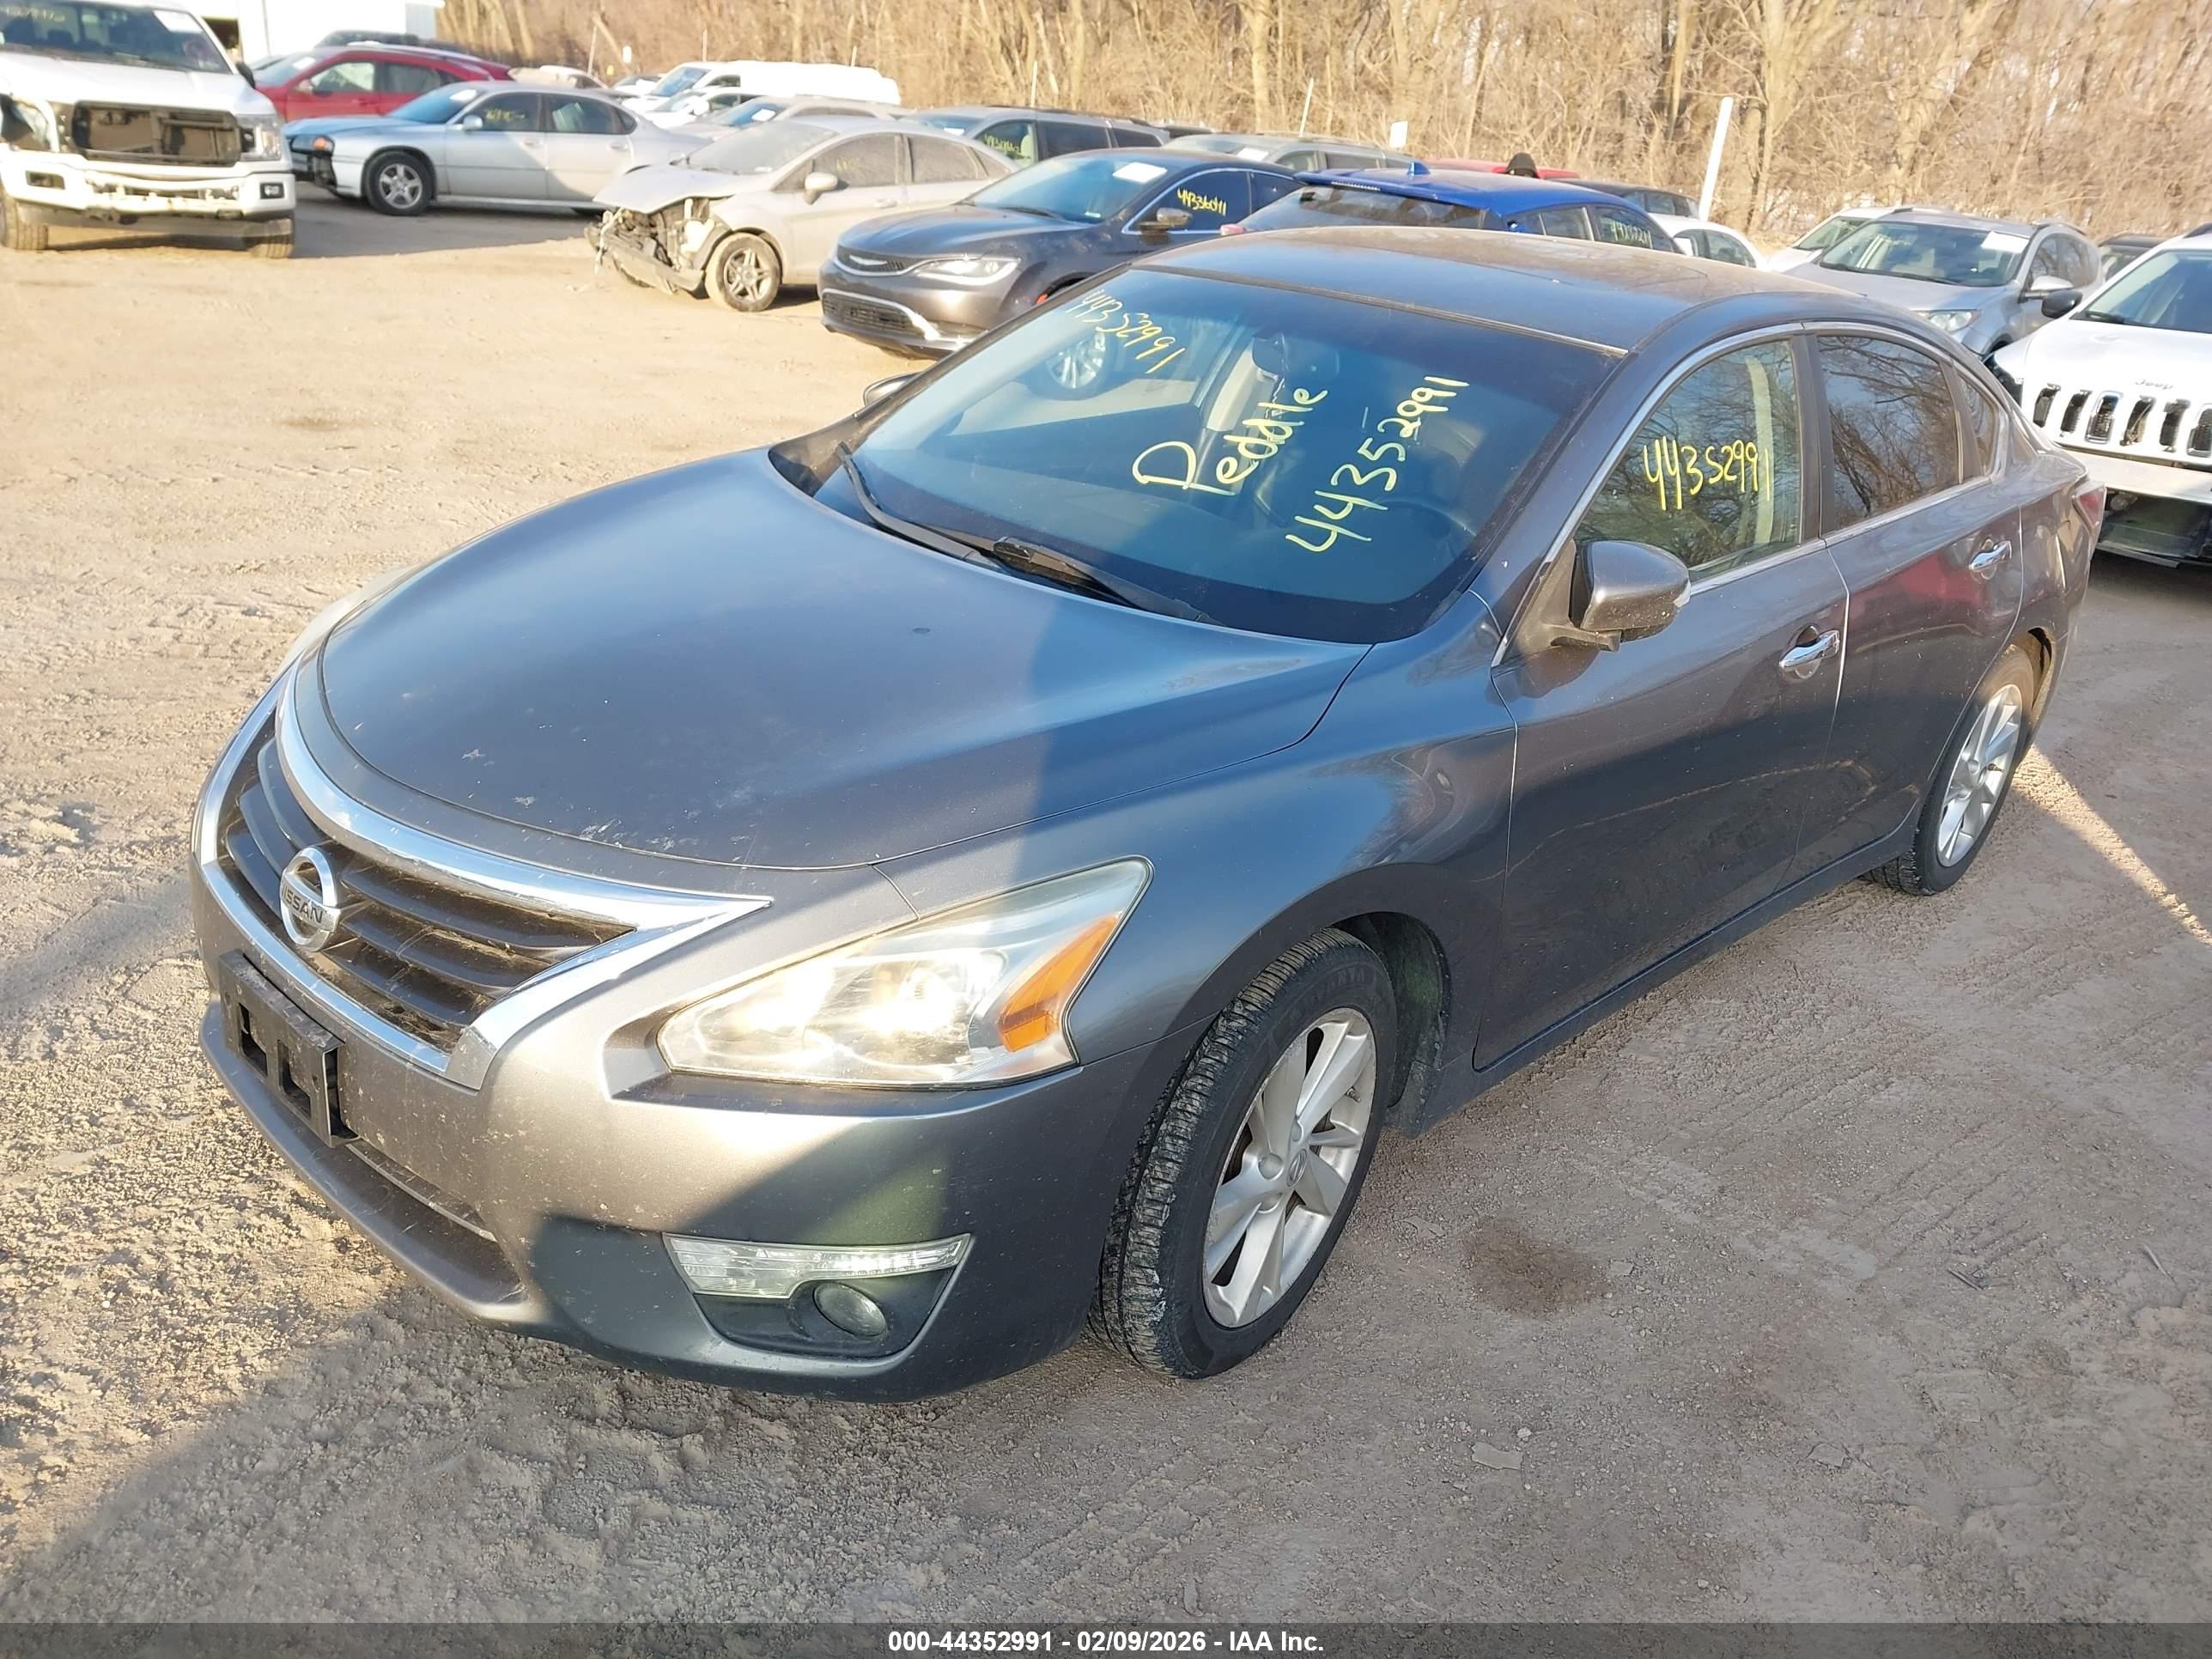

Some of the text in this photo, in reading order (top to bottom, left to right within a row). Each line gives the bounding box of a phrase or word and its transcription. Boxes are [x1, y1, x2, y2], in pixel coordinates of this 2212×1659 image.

[1065, 289, 1186, 374] 44352991
[2135, 379, 2174, 390] Jeep
[1132, 387, 1329, 496] Peddle
[1285, 375, 1470, 553] 44352991
[1644, 435, 1771, 511] 44352991
